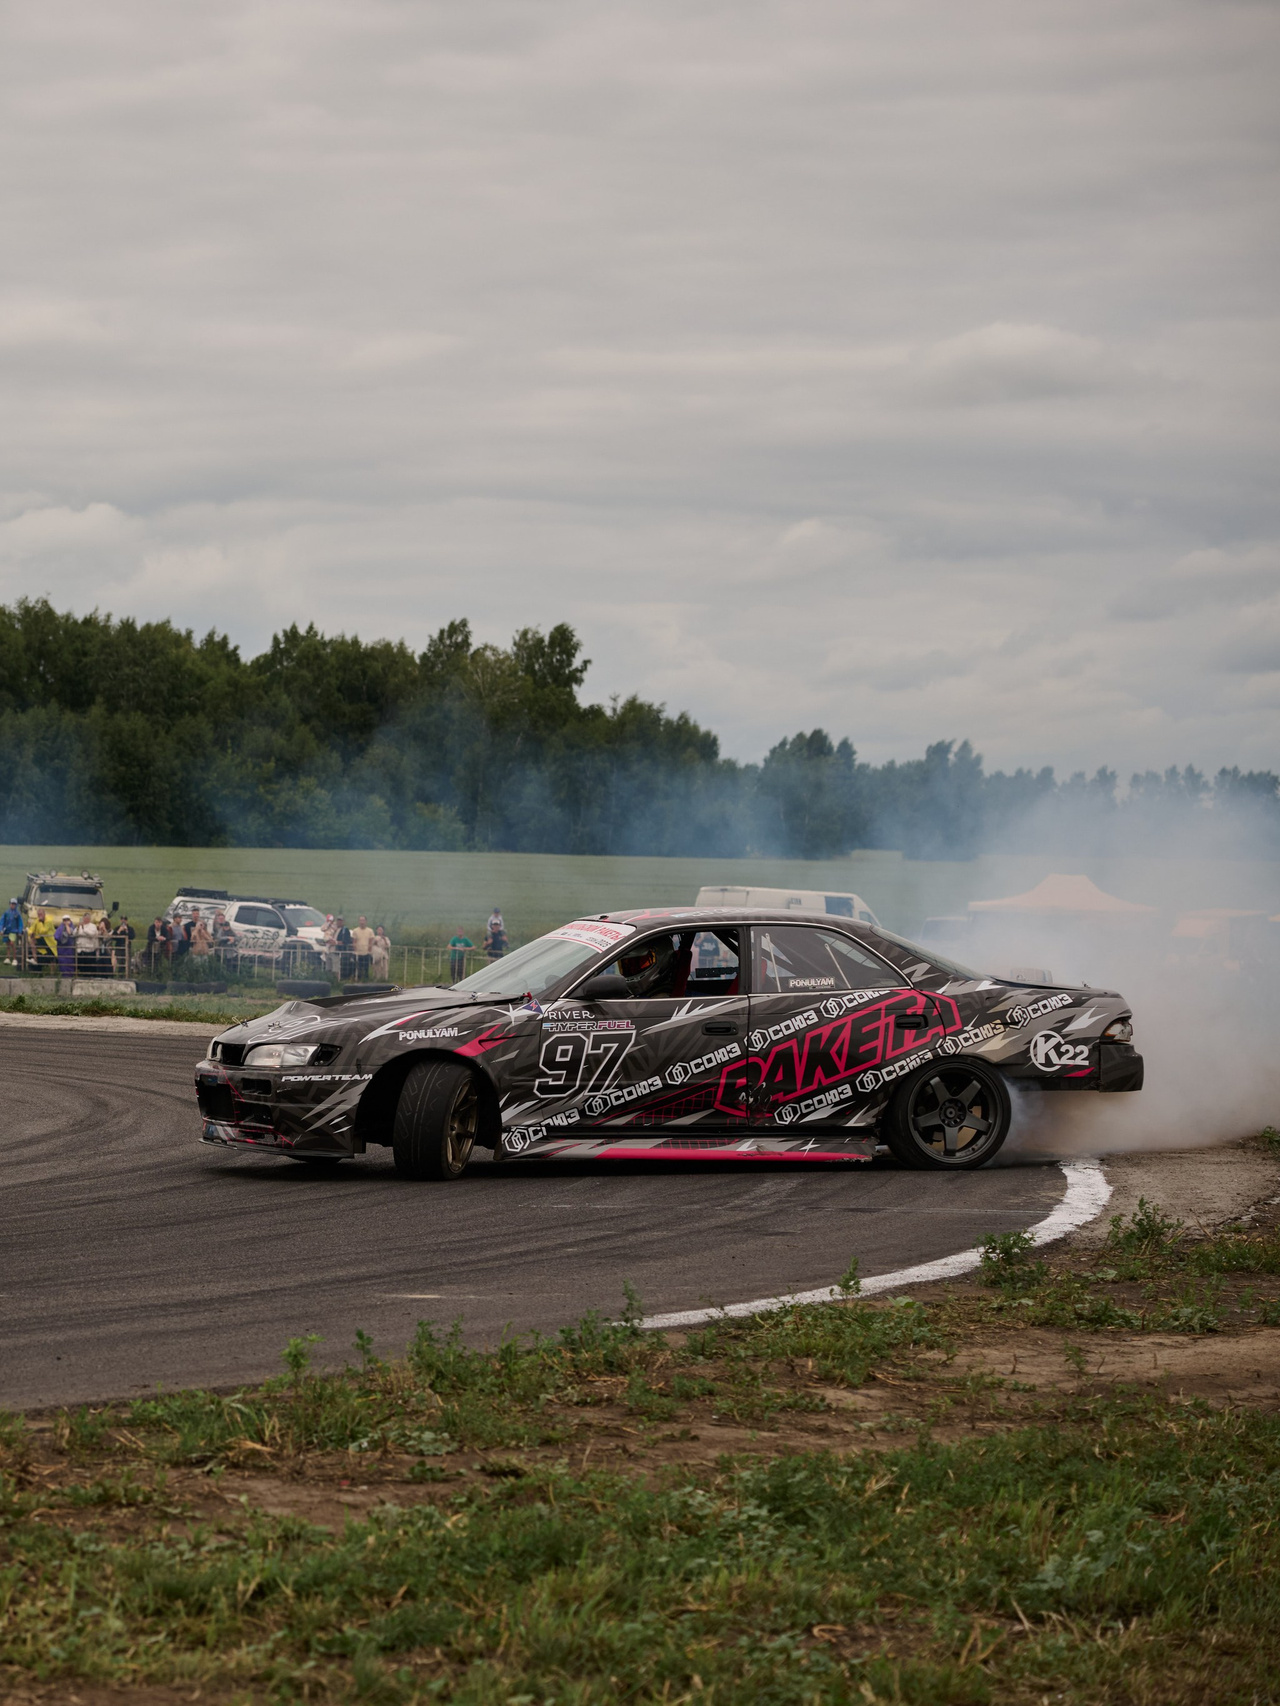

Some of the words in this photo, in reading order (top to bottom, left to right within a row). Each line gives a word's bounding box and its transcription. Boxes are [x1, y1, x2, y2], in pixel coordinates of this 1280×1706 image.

[233, 937, 281, 950] АКЕТА
[789, 977, 835, 987] PONULYAM
[548, 1010, 595, 1020] RIVER
[1028, 993, 1073, 1019] СОЮЗ
[398, 1027, 458, 1041] PONULYAM
[769, 1010, 819, 1041] СОЮЗ
[963, 1019, 1004, 1048] СОЮЗ
[533, 1030, 637, 1098] 97
[689, 1042, 742, 1074] СОЮЗ
[611, 1076, 664, 1107] СОЮЗ
[801, 1083, 853, 1114] СОЮЗ
